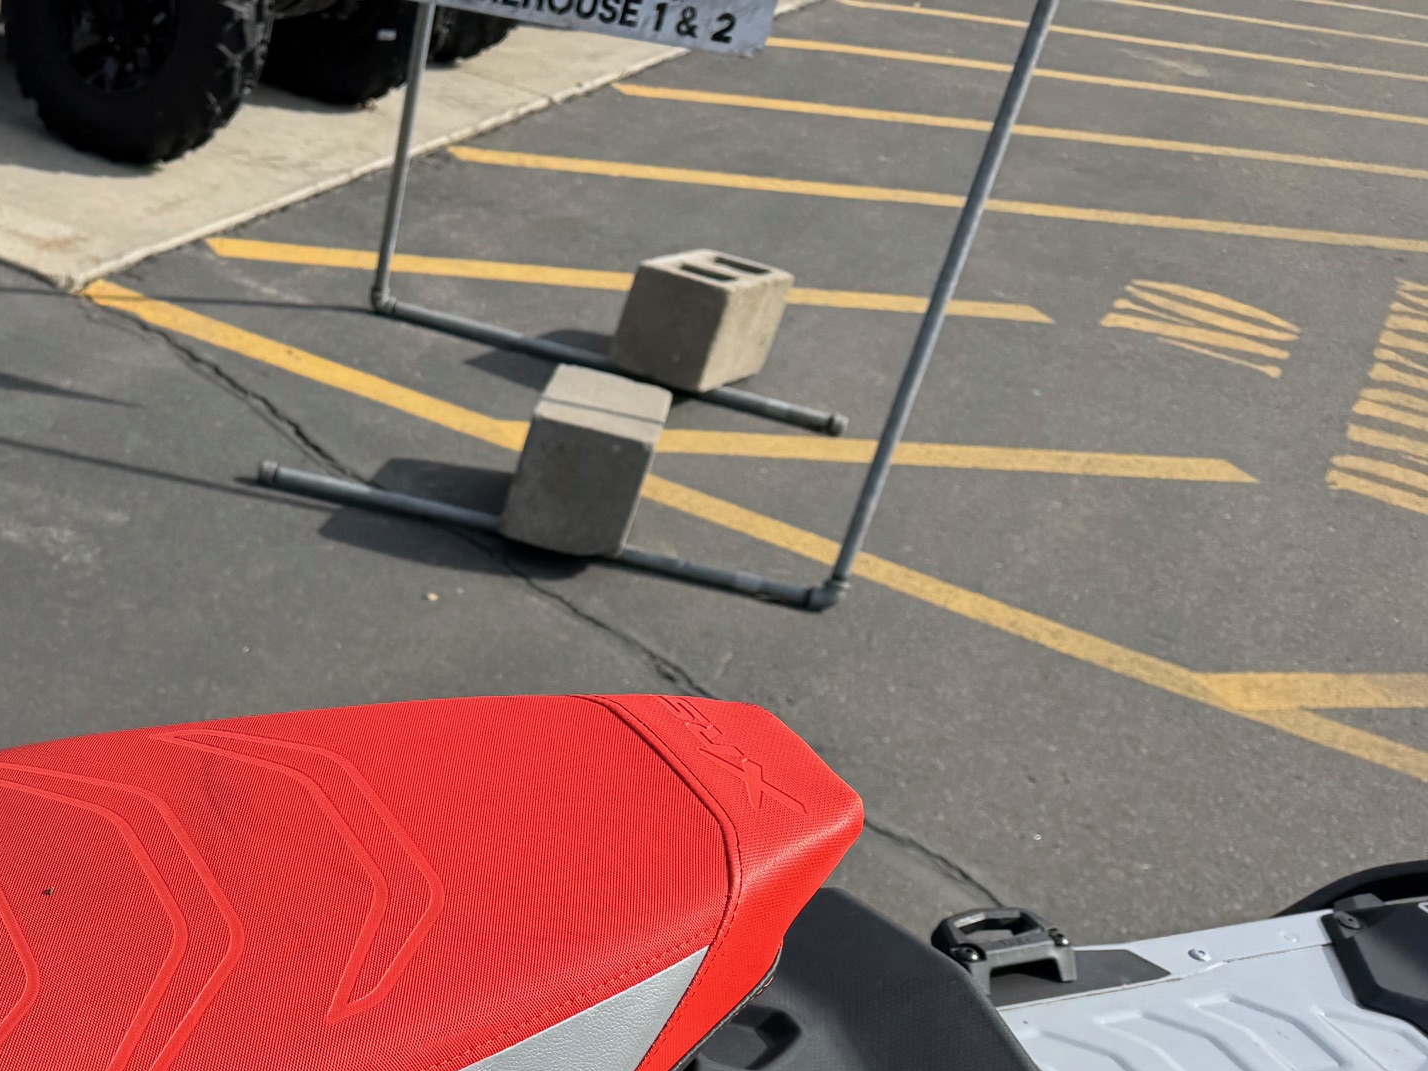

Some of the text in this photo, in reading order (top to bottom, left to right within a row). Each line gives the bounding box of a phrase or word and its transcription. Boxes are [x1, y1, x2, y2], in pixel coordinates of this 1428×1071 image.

[653, 3, 670, 32] 1
[676, 6, 699, 39] &
[710, 13, 737, 44] 2
[1098, 278, 1304, 379] NO
